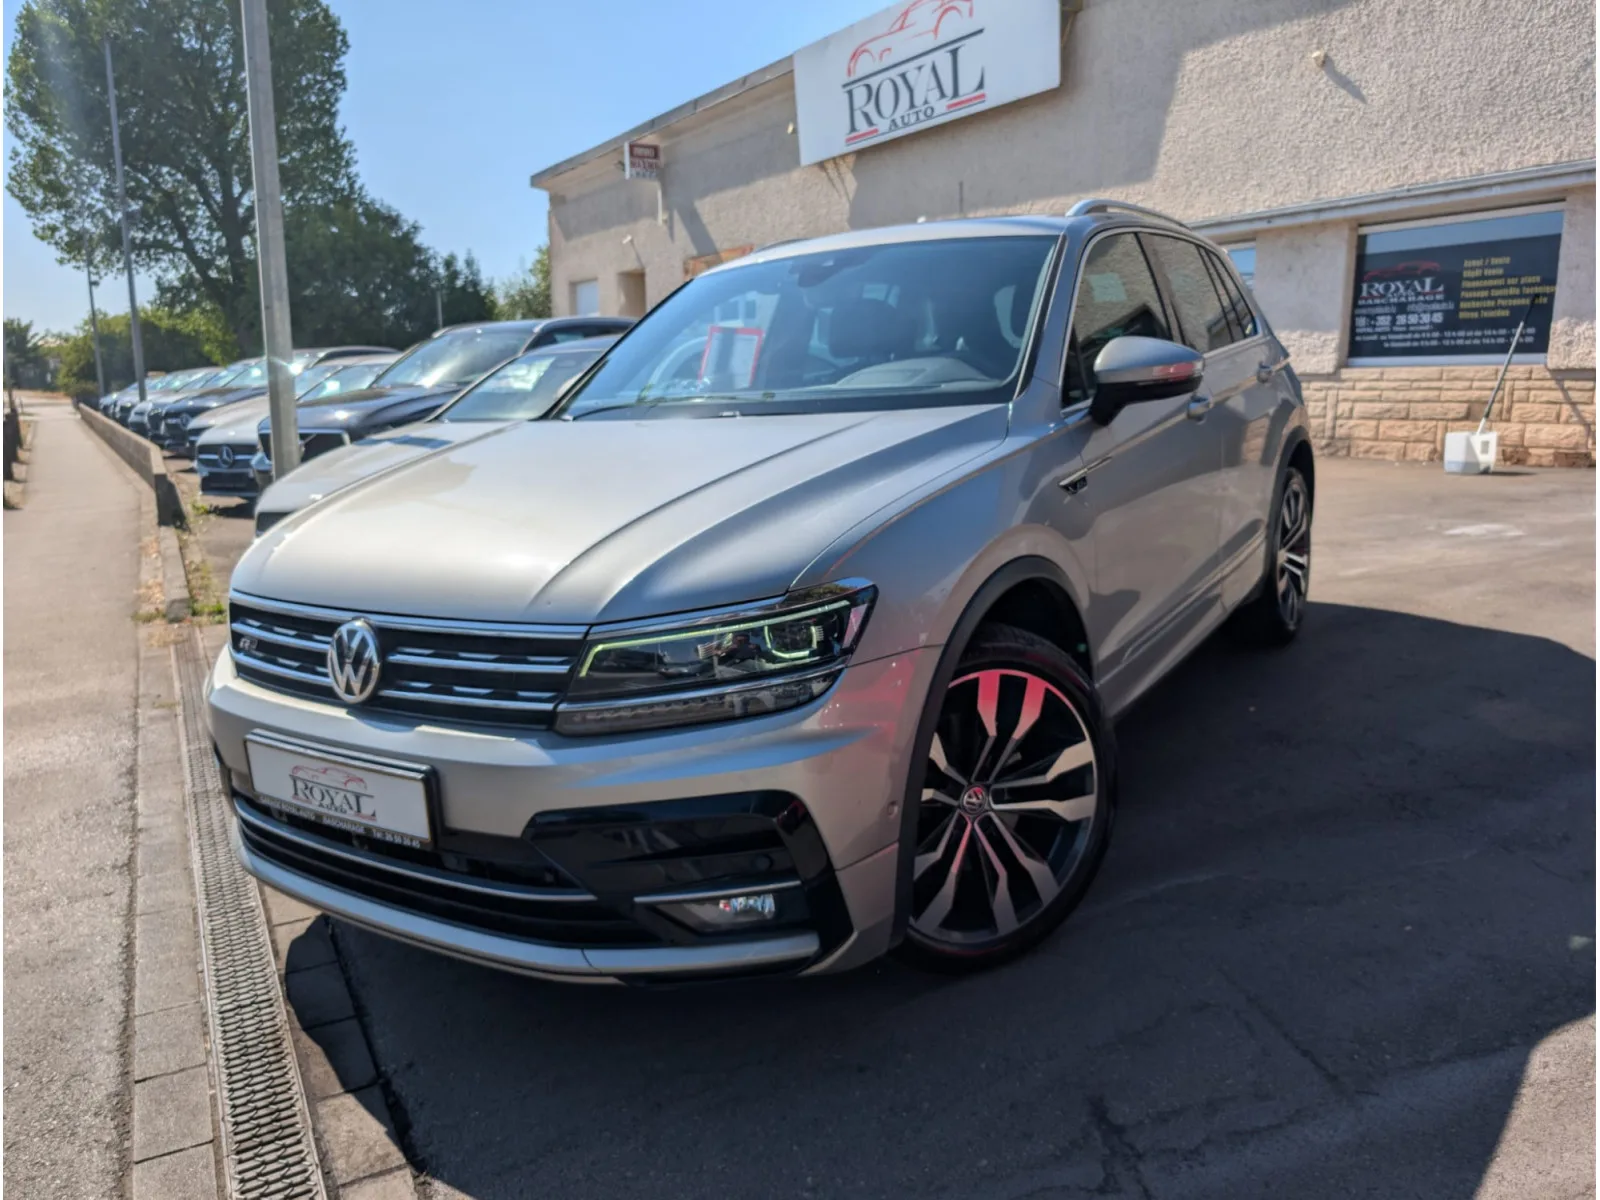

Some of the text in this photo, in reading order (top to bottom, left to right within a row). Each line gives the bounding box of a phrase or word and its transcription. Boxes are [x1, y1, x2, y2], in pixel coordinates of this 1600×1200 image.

[843, 44, 985, 135] ROYAL
[888, 106, 935, 131] AUTO
[1359, 276, 1444, 298] ROYAL
[291, 777, 377, 817] ROYAL
[318, 801, 348, 815] AUTO
